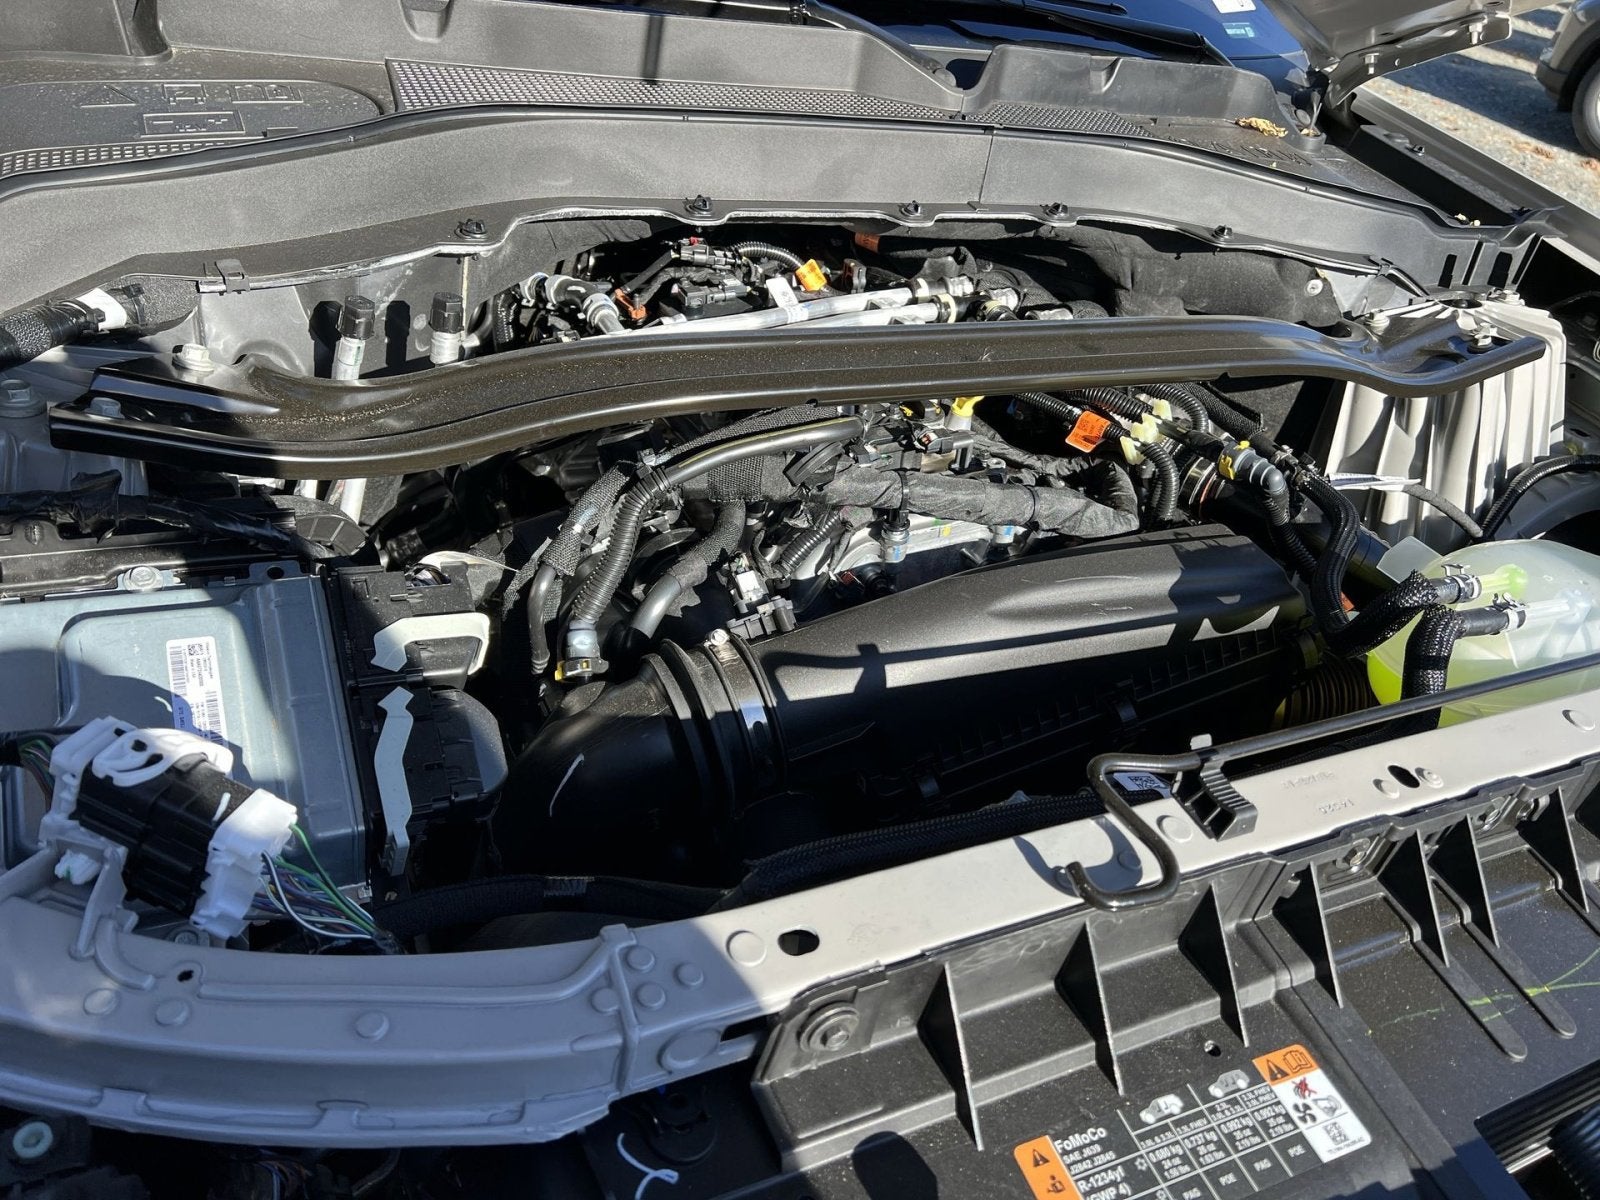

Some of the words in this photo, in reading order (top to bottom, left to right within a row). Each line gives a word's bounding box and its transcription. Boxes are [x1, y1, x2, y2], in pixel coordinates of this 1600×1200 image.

[1272, 1105, 1286, 1114] kg
[1239, 1117, 1253, 1127] kg
[1054, 1128, 1106, 1153] FoMoCo
[1204, 1131, 1218, 1141] kg
[1169, 1144, 1183, 1155] kg
[1063, 1151, 1082, 1164] SAE
[1077, 1166, 1124, 1192] R-1234yf
